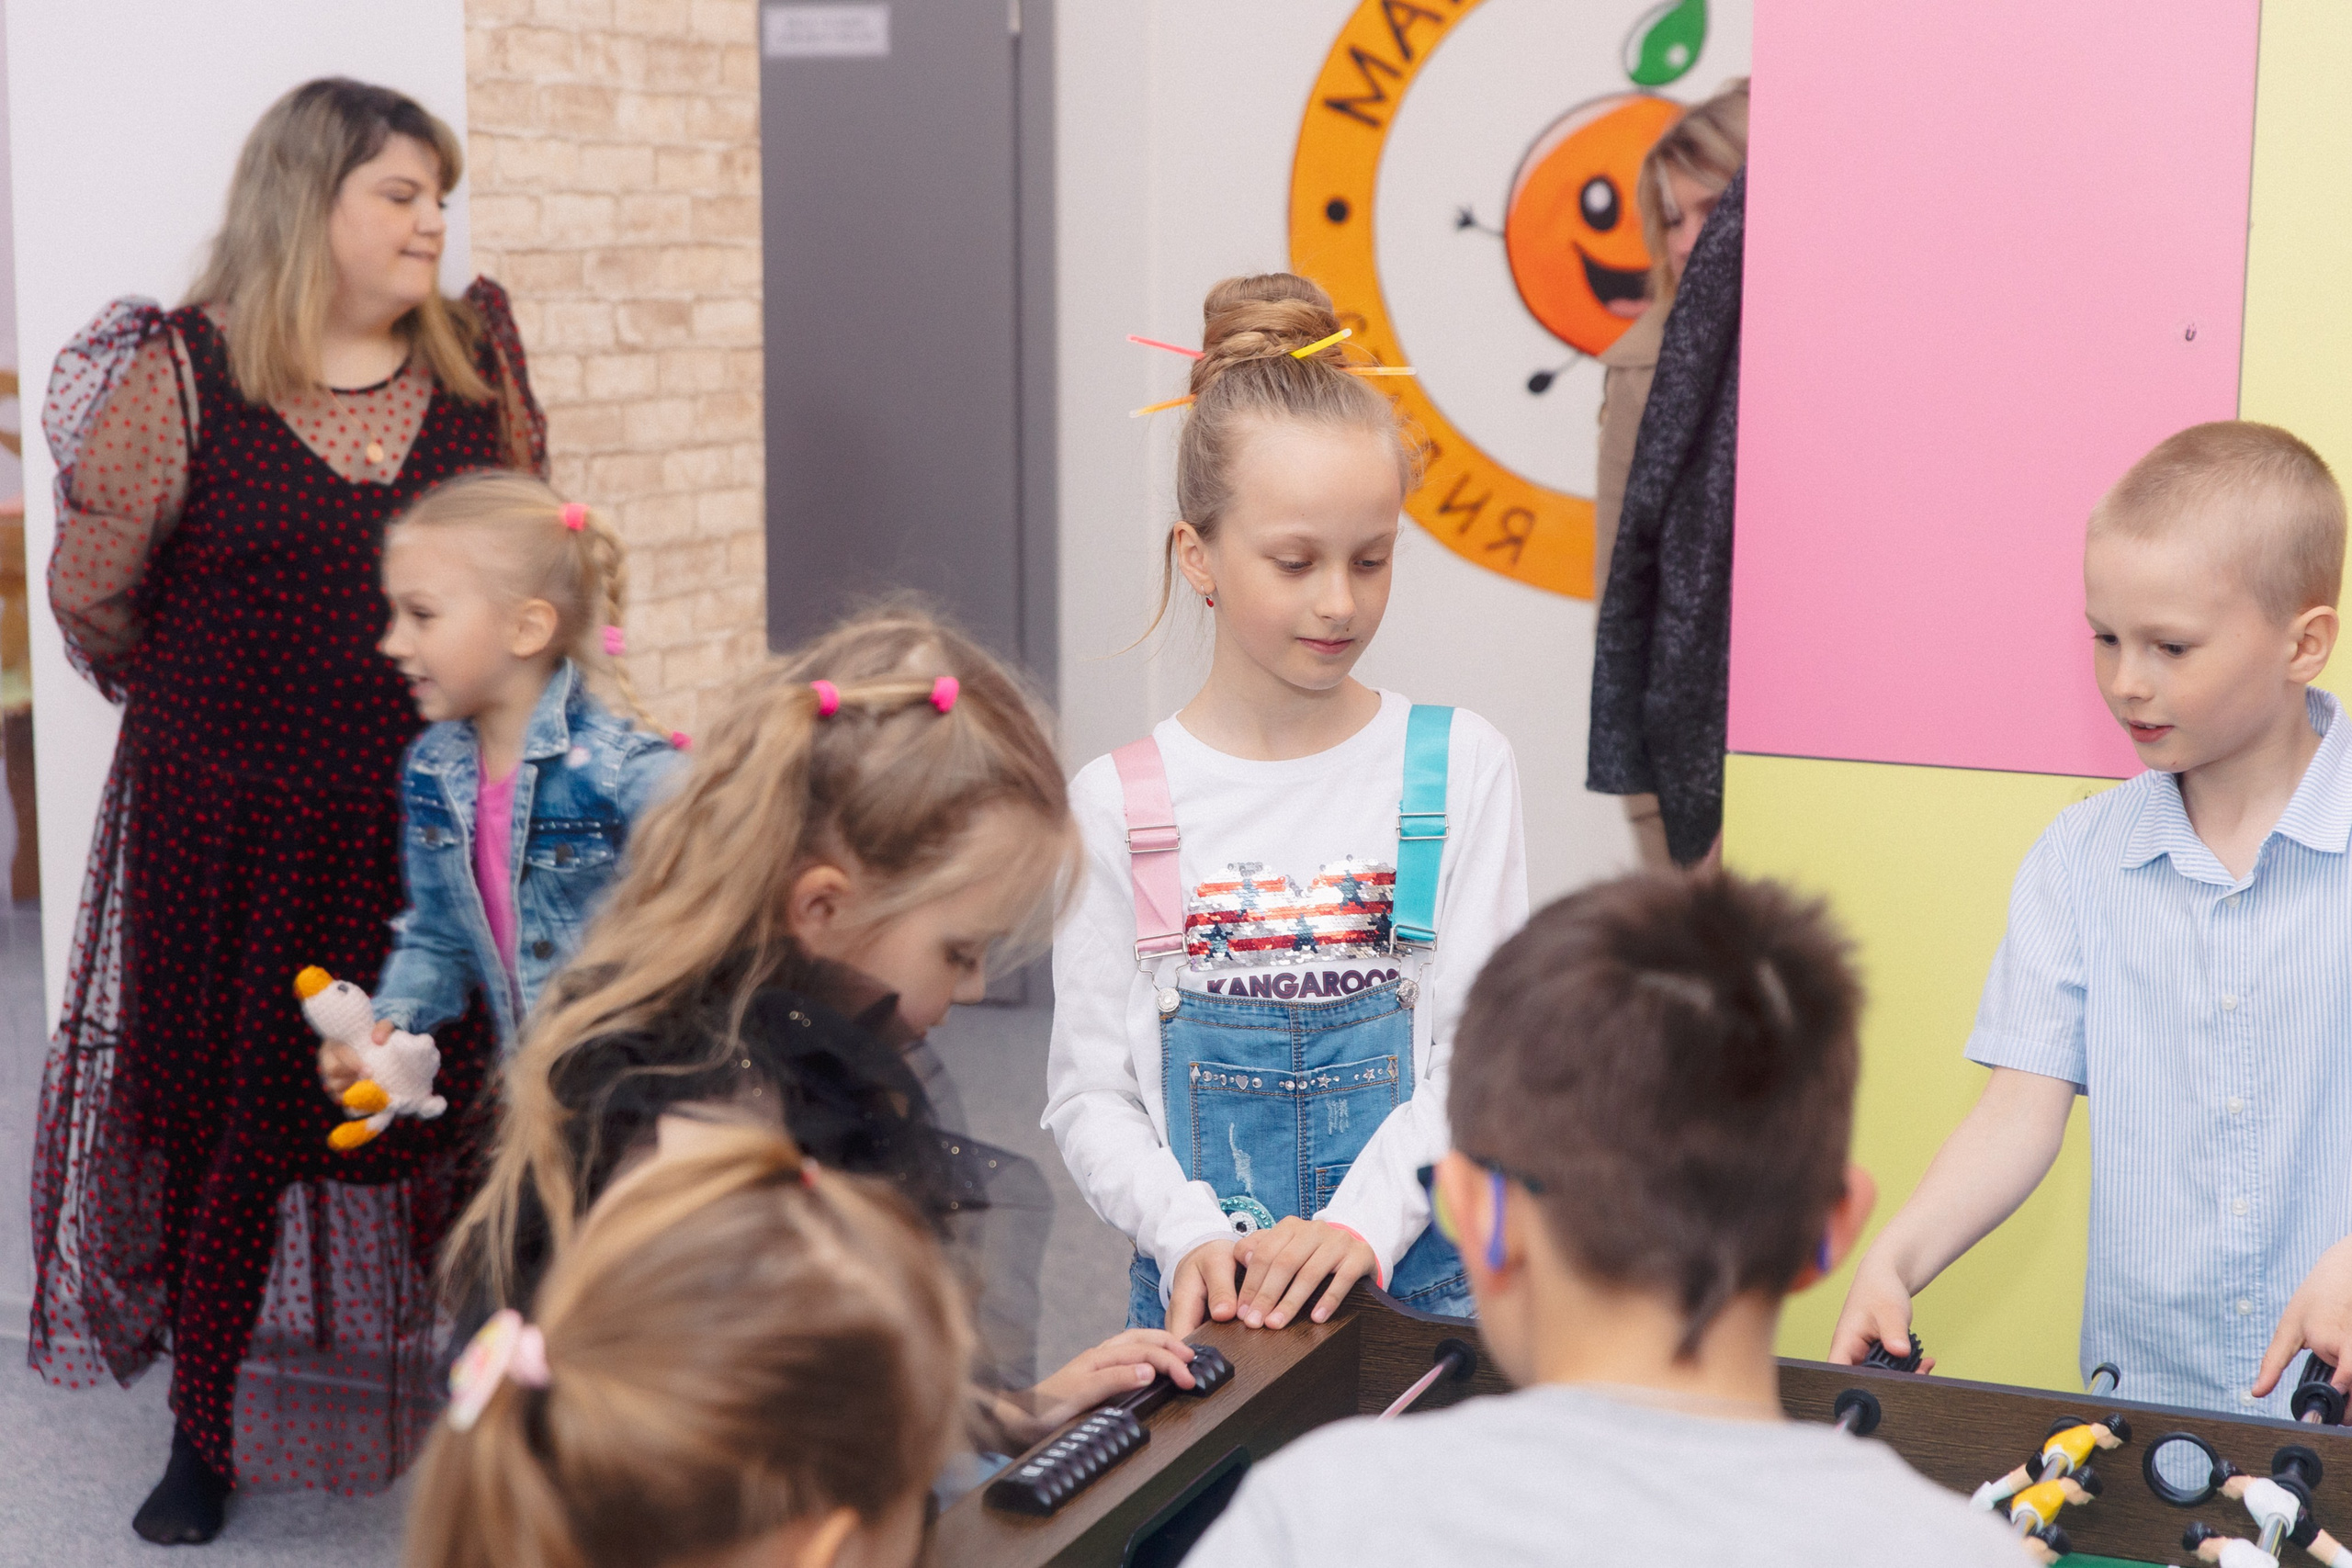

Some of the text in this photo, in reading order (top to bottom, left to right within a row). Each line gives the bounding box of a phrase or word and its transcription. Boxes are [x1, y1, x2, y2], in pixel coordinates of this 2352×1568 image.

[1081, 1425, 1101, 1433] 5
[1069, 1433, 1089, 1441] 6
[1059, 1441, 1079, 1450] 7
[1046, 1449, 1067, 1458] 8
